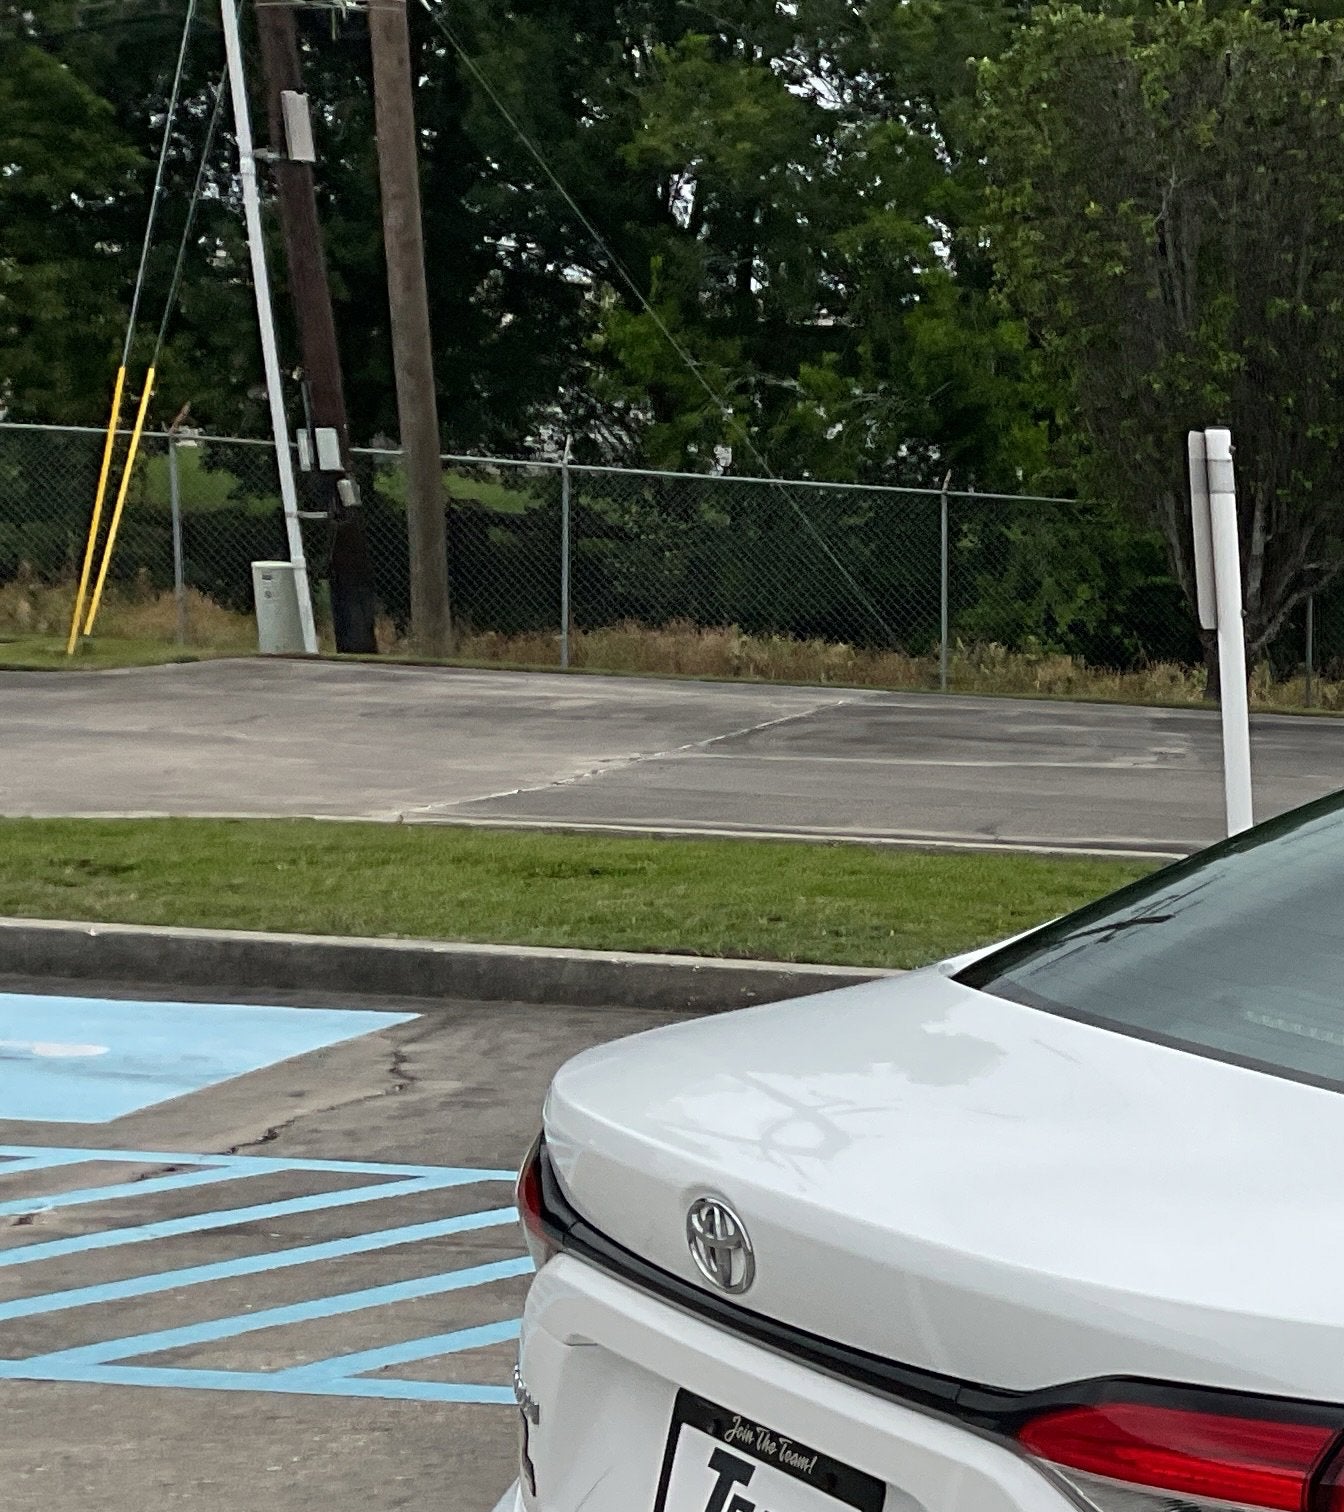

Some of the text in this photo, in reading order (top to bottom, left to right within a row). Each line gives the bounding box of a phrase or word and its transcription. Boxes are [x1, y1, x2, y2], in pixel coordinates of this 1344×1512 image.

[724, 1415, 818, 1474] Join The Team!
